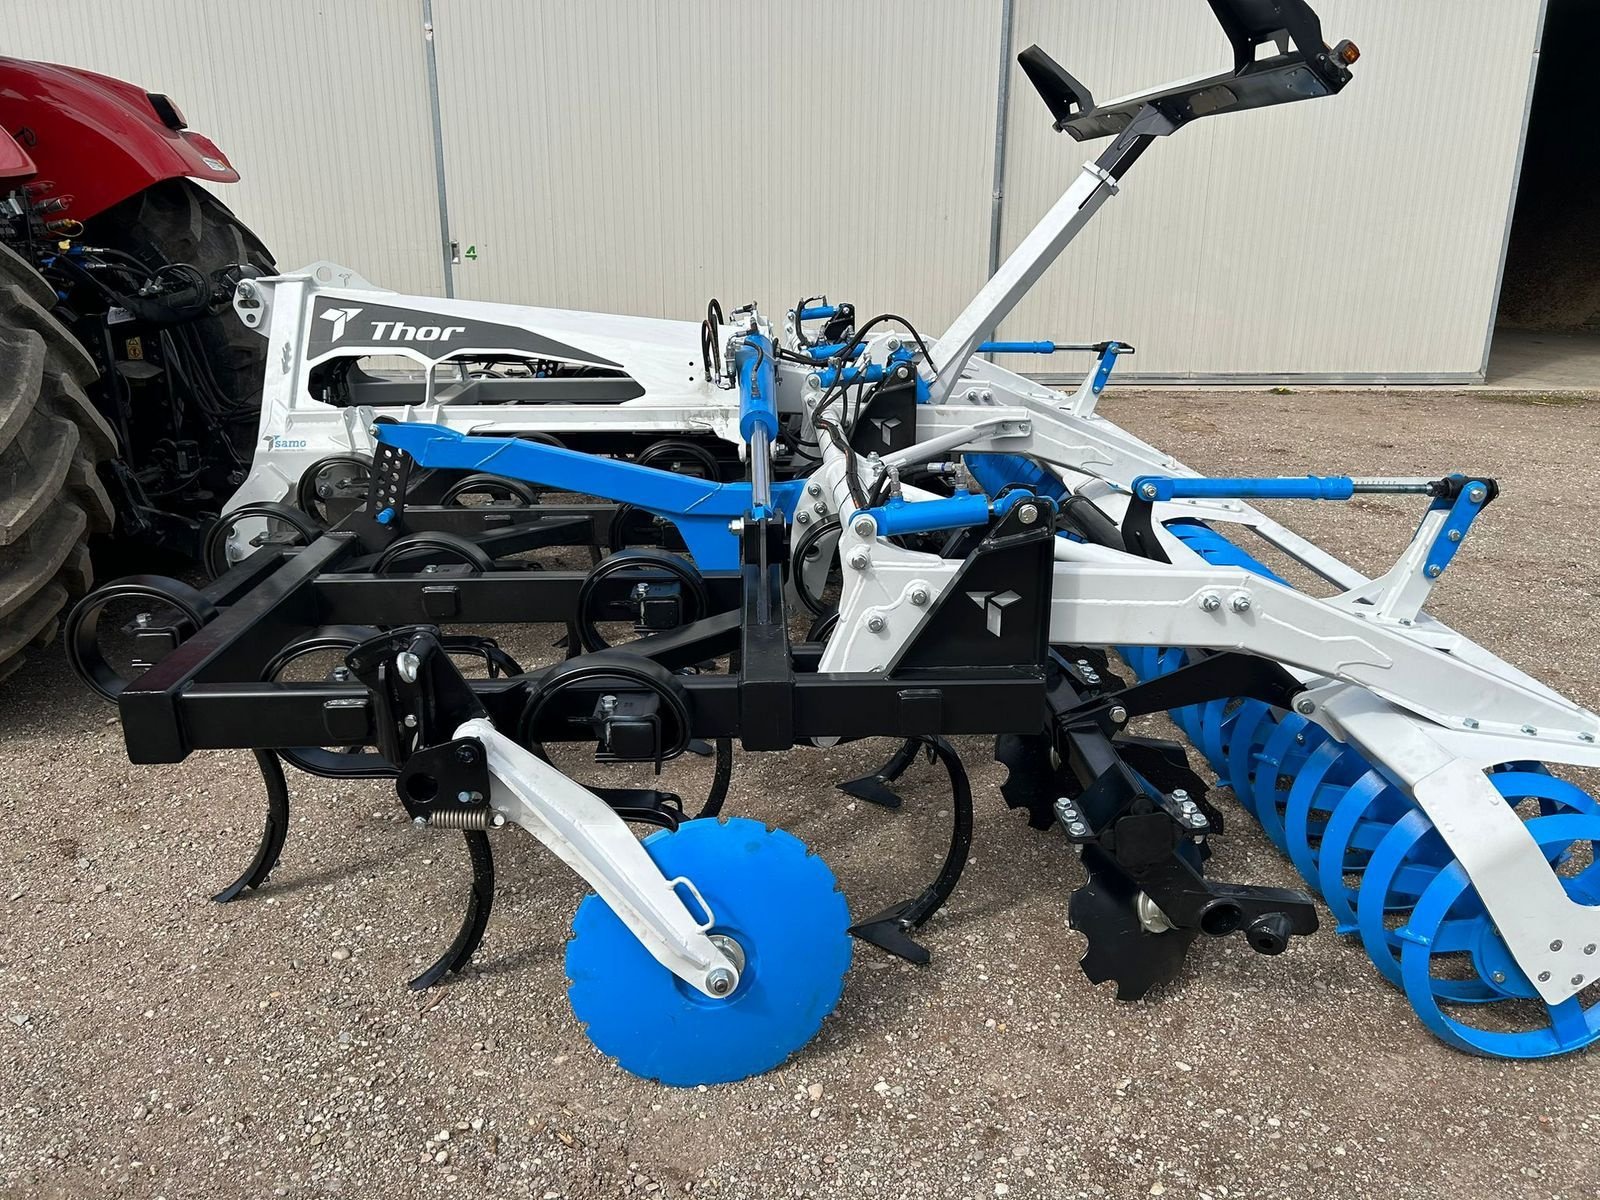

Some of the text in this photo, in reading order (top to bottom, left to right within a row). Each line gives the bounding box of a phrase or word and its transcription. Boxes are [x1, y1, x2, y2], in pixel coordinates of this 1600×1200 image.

[465, 245, 477, 260] 4
[370, 321, 466, 341] Thor
[274, 439, 306, 448] samo
